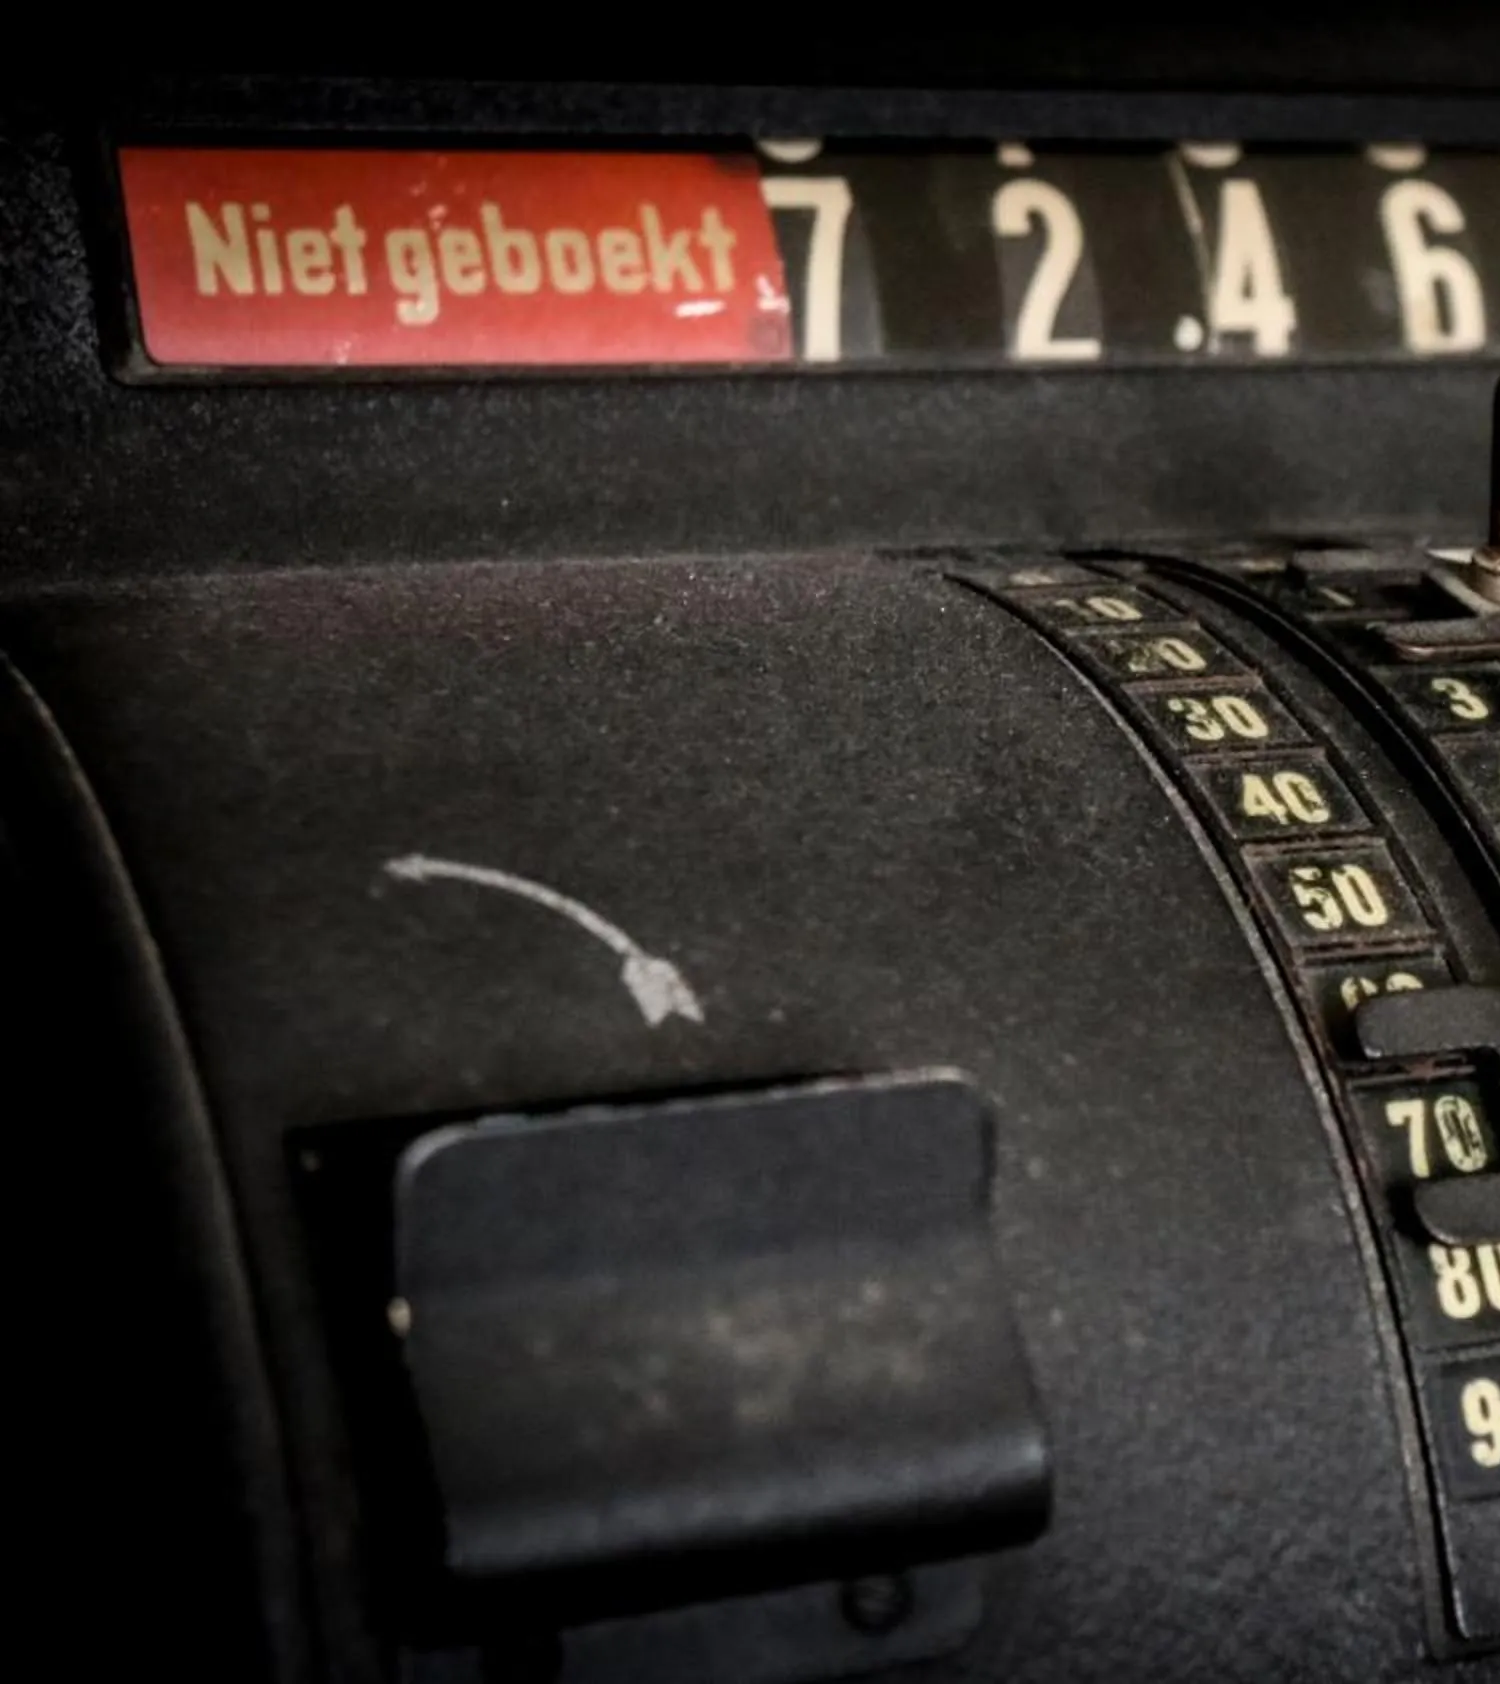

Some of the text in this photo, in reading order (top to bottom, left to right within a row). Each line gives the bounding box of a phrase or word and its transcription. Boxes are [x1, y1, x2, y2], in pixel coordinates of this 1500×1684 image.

[185, 201, 737, 325] Niet geboekt
[760, 176, 853, 362] 7
[991, 178, 1101, 360] 2
[1380, 179, 1487, 353] 6
[1167, 695, 1269, 741] 30
[1431, 677, 1489, 720] 3
[1241, 771, 1330, 827] 40
[1289, 864, 1389, 931] 50
[1385, 1094, 1489, 1179] 70
